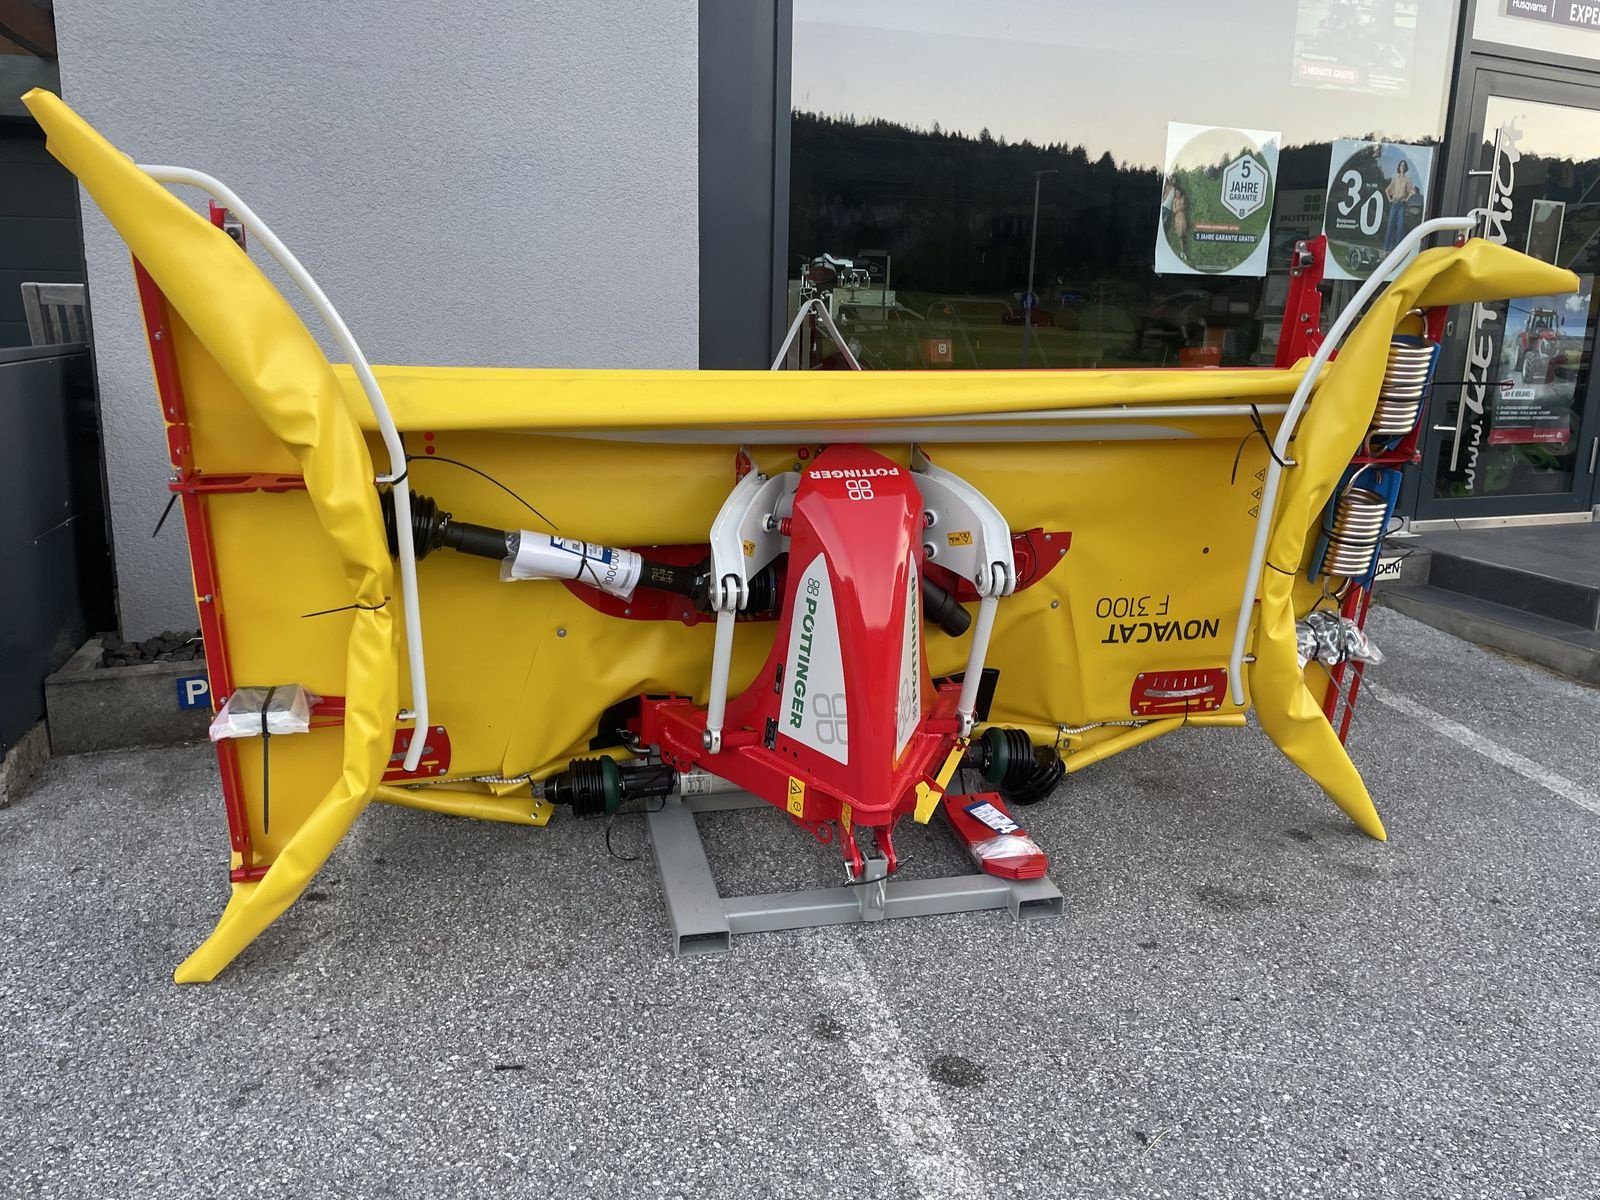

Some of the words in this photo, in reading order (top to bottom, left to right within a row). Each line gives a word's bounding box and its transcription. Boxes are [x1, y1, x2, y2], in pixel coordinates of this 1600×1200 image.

[1511, 0, 1547, 13] Husqvarna
[1569, 4, 1600, 26] EXPE
[1241, 161, 1251, 178] 5
[1229, 194, 1257, 202] GARANTIE
[1230, 181, 1259, 193] JAHRE
[1377, 563, 1400, 574] DEN
[1096, 595, 1151, 618] 3100
[1156, 594, 1170, 616] F
[1101, 618, 1220, 644] NOVACAT
[790, 597, 817, 729] PÖTTINGER
[186, 679, 208, 705] P
